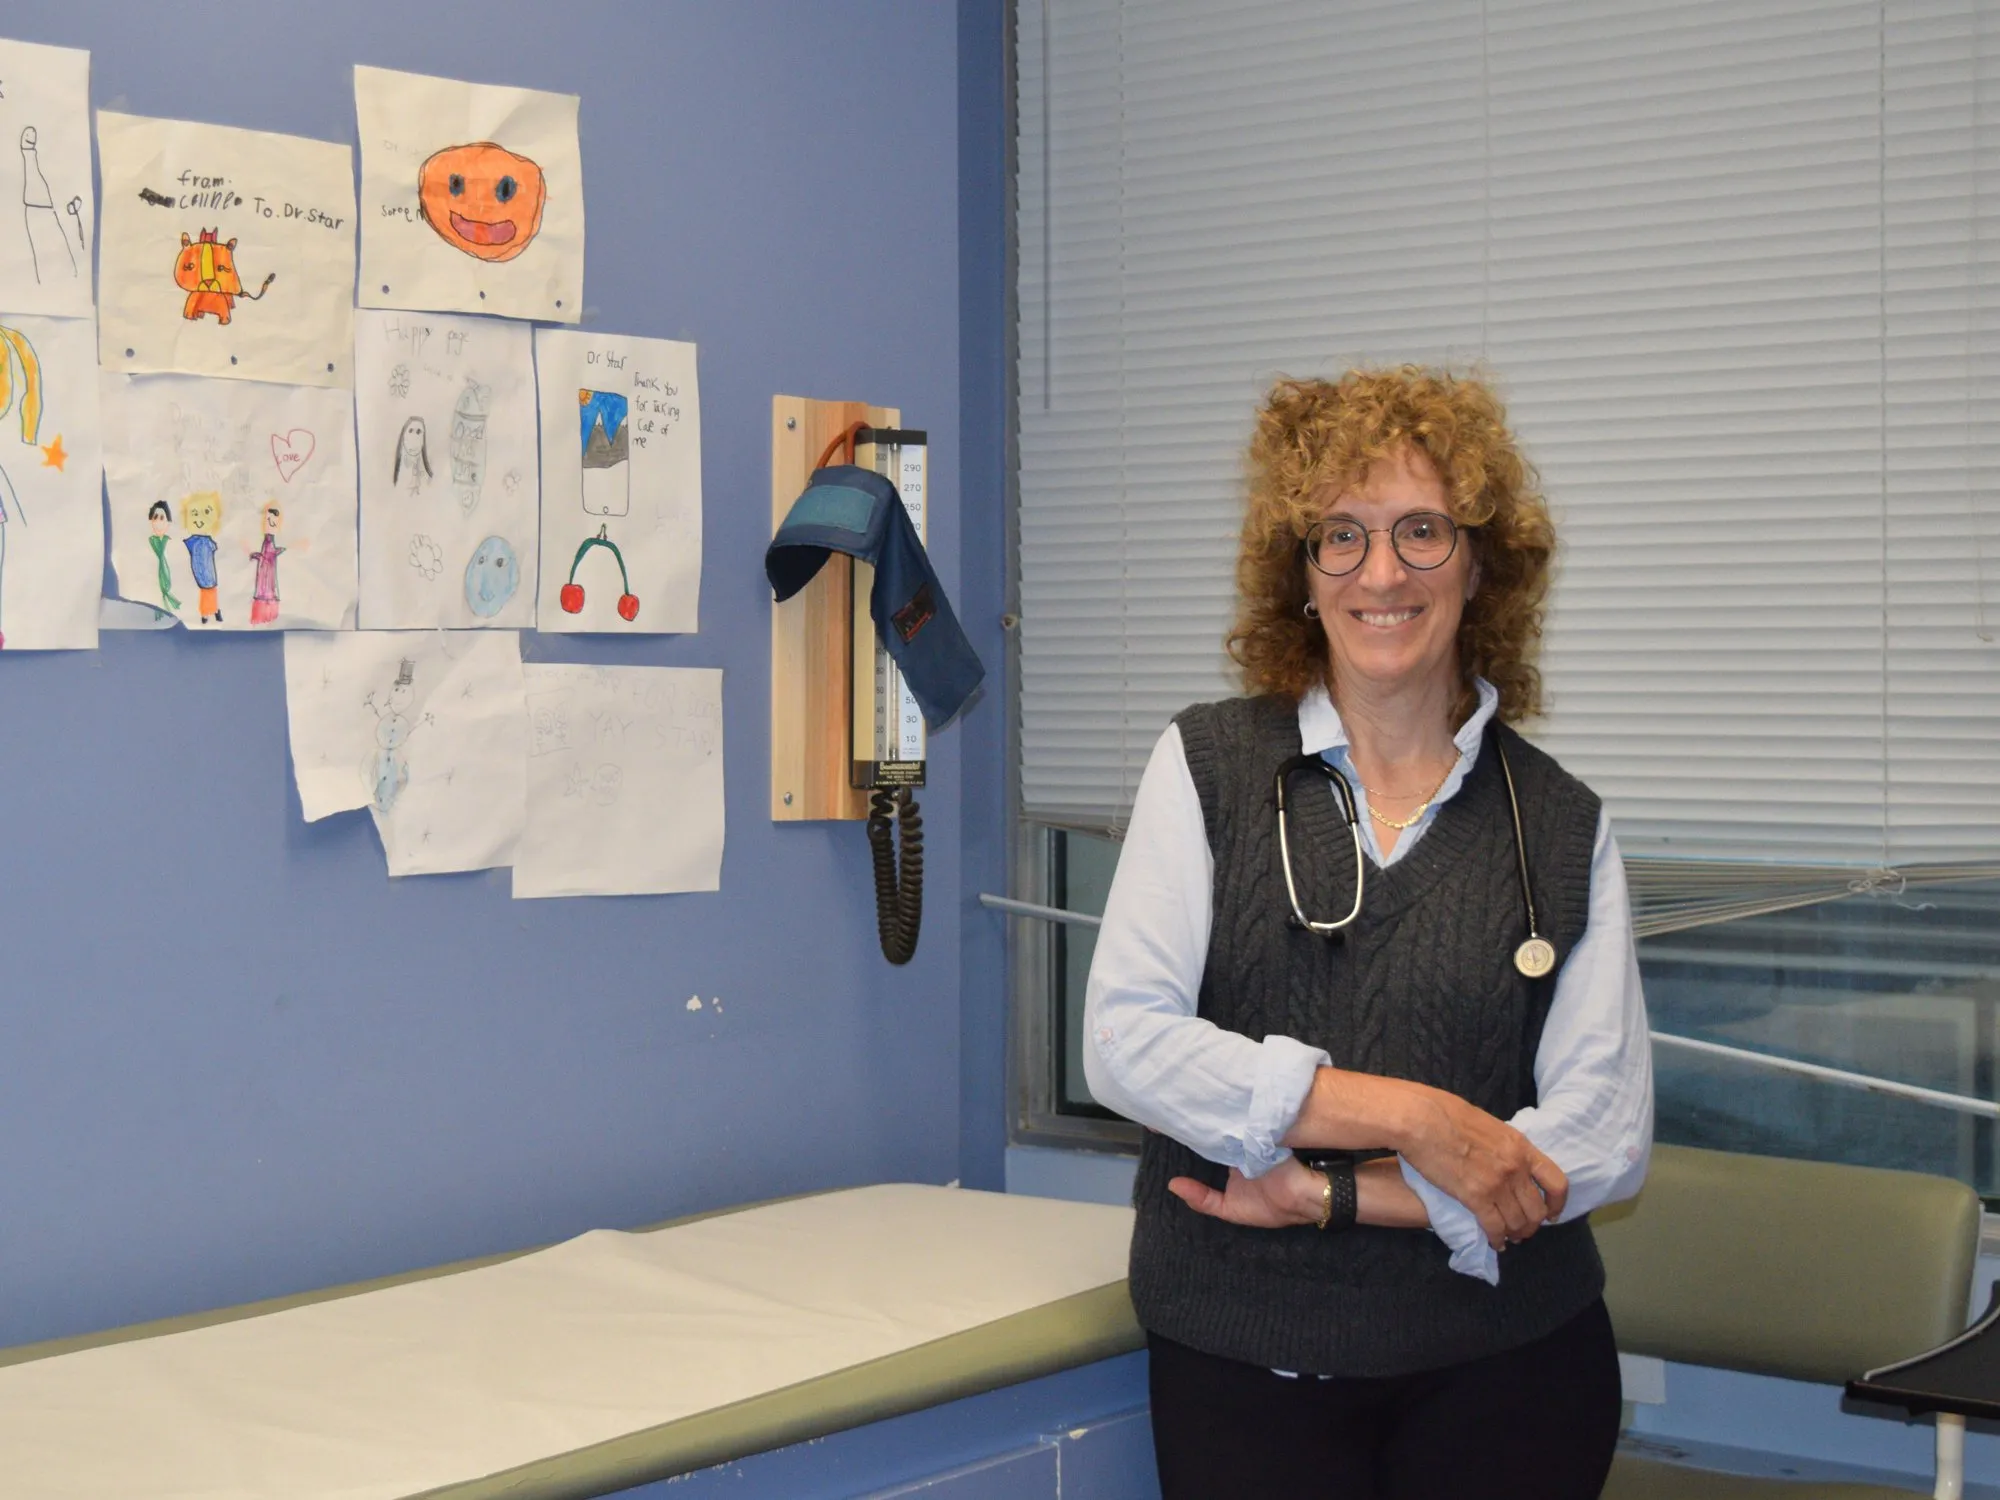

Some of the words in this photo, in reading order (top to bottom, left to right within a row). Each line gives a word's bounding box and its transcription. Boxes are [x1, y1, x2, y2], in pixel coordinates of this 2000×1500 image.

[903, 463, 922, 473] 290
[903, 483, 922, 493] 270
[905, 715, 918, 724] 30
[905, 735, 918, 743] 10
